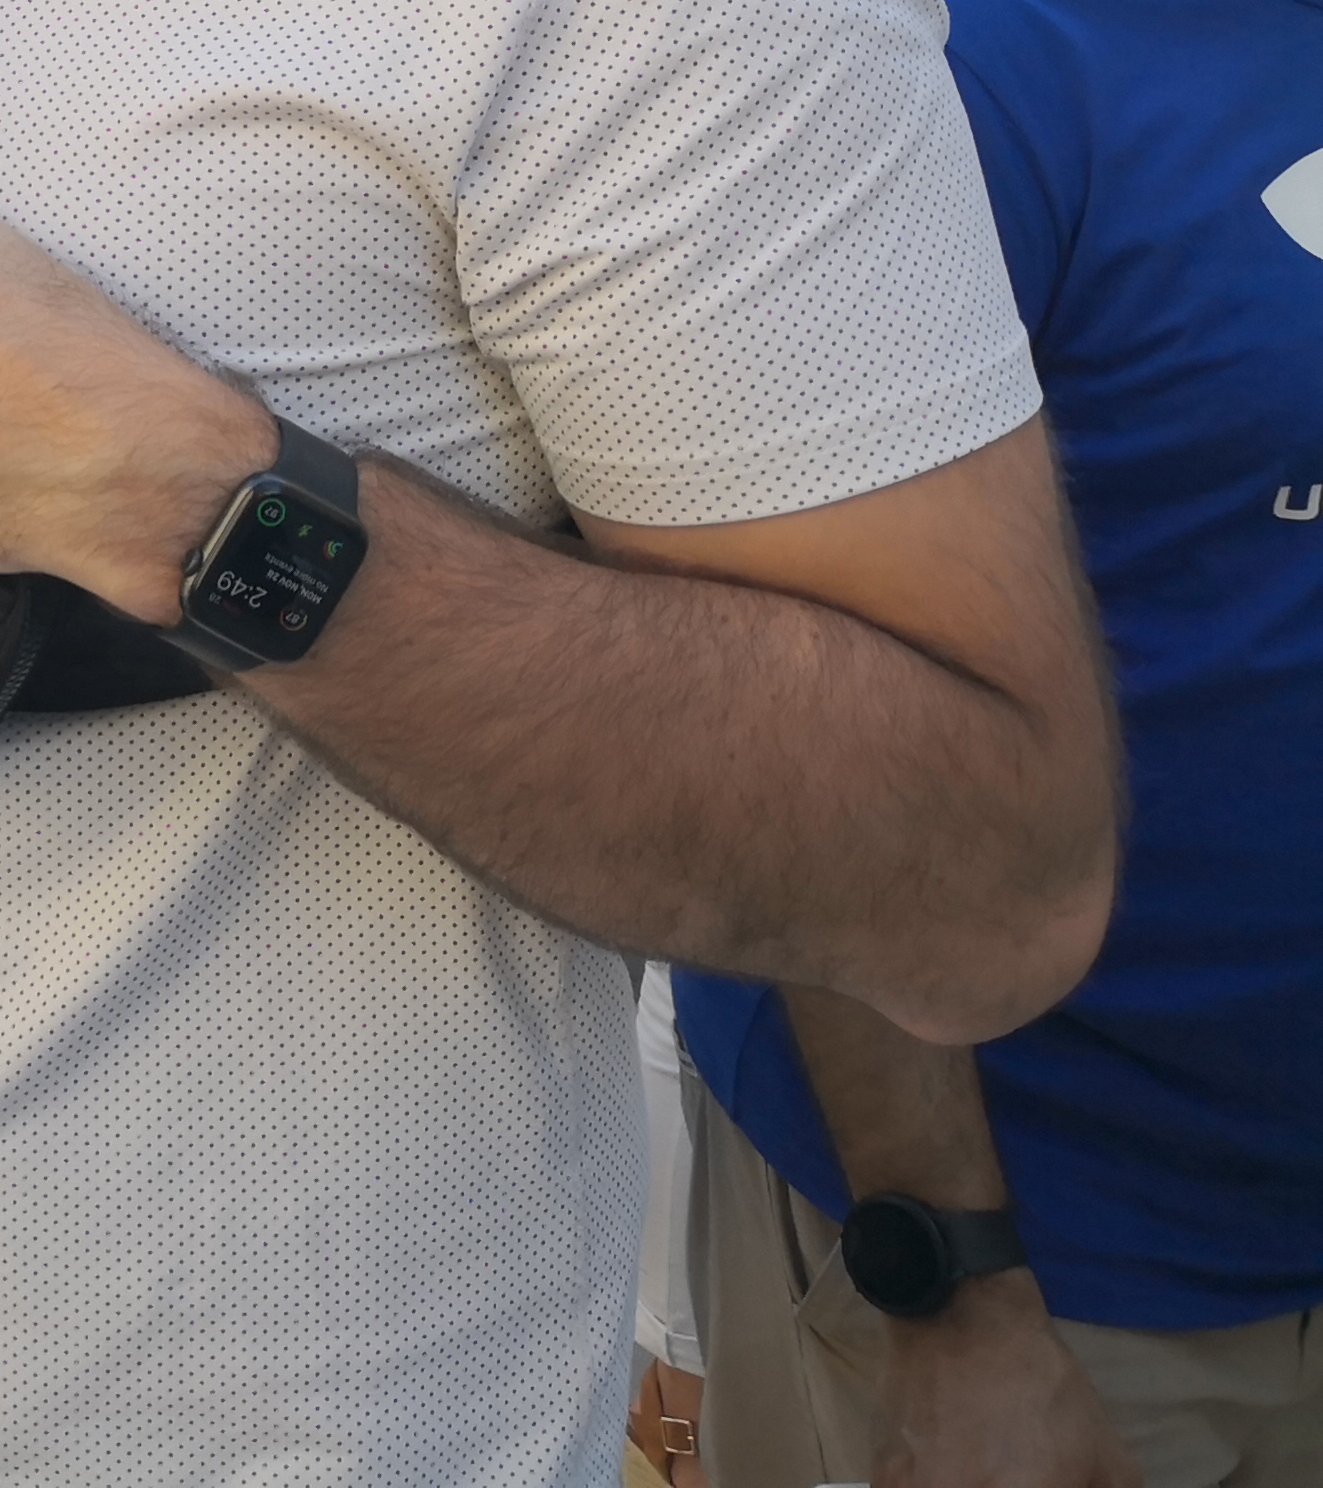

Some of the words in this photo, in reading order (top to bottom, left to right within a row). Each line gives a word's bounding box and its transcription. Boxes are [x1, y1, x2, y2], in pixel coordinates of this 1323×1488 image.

[264, 552, 294, 572] events
[278, 576, 299, 592] NOV
[293, 570, 316, 585] more
[217, 570, 267, 608] 2:49
[316, 581, 329, 593] No
